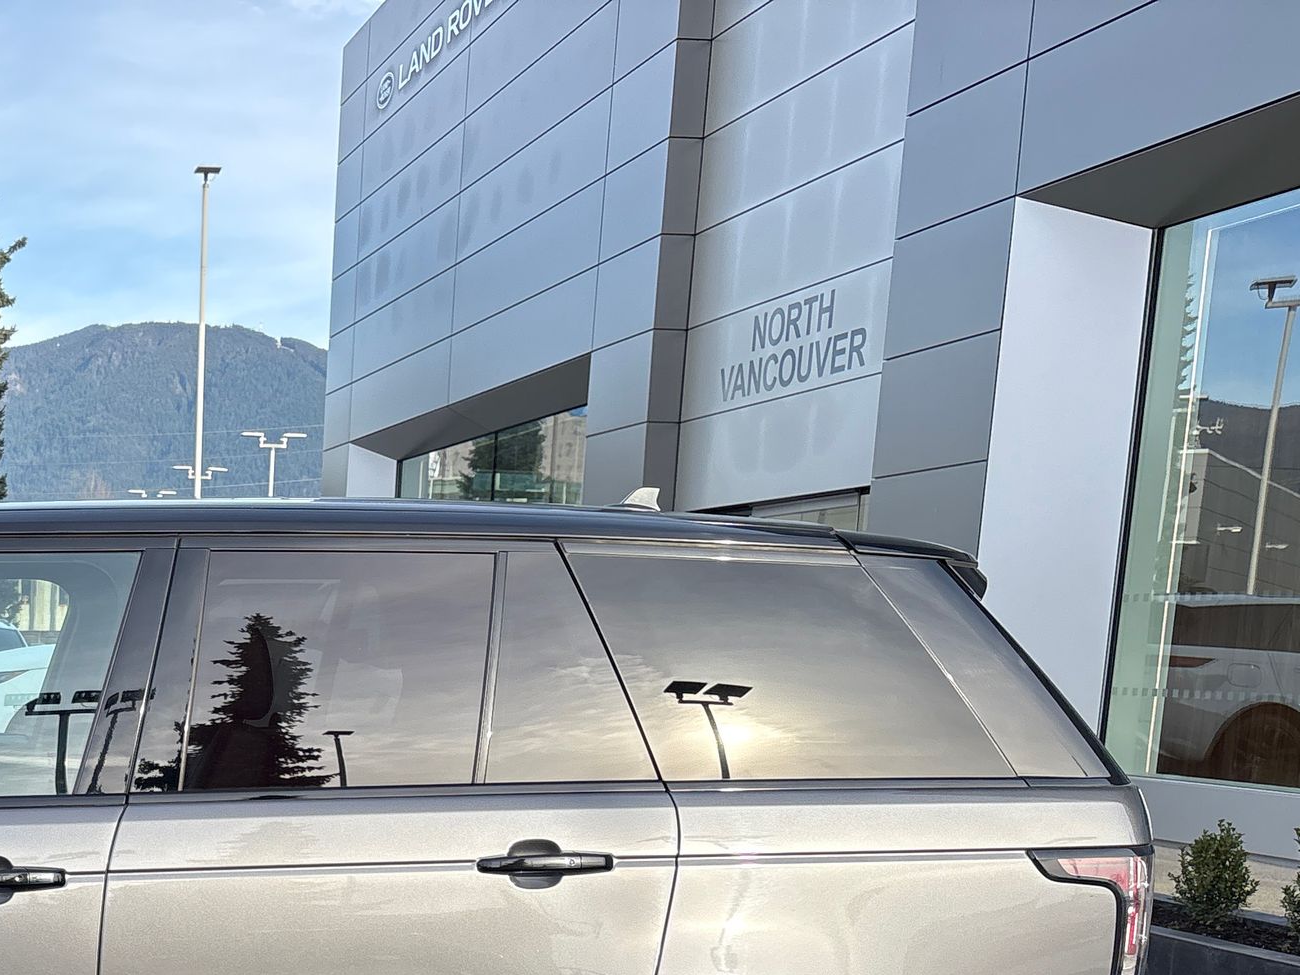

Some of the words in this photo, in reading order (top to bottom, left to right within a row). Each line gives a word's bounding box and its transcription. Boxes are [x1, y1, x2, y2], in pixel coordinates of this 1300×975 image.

[398, 26, 444, 90] LAND
[446, 0, 494, 44] ROV
[751, 289, 836, 352] NORTH
[720, 327, 867, 402] VANCOUVER
